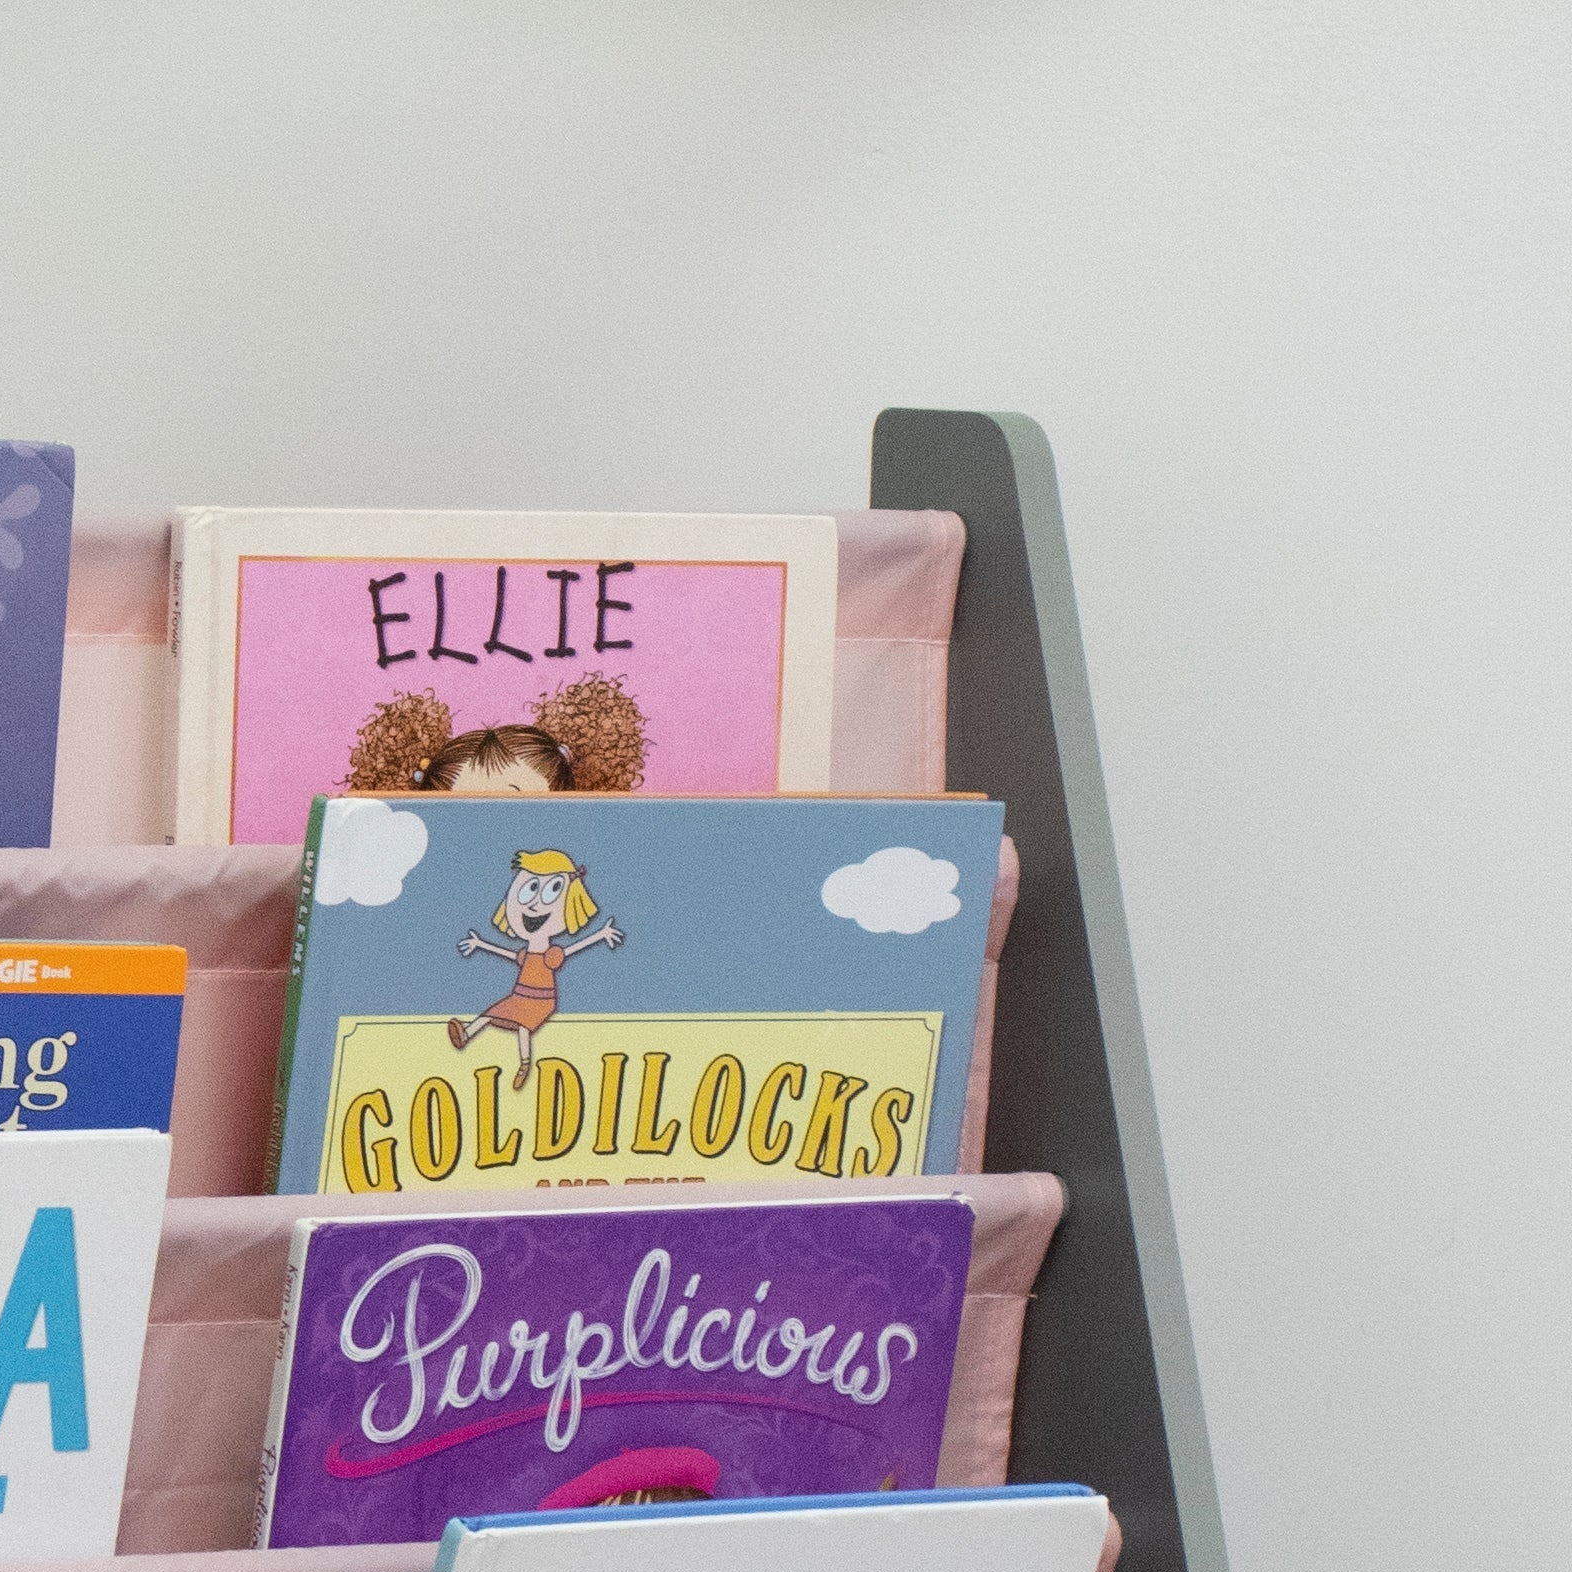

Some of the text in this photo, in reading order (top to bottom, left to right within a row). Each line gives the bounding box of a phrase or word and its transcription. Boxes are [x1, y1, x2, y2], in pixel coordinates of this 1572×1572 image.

[171, 609, 183, 658] Fowler
[370, 562, 634, 667] ELLIE
[292, 850, 315, 977] WILLEMS
[41, 964, 72, 980] Book
[342, 1052, 913, 1193] GOLDILOCKS
[340, 1242, 919, 1452] Purplicious
